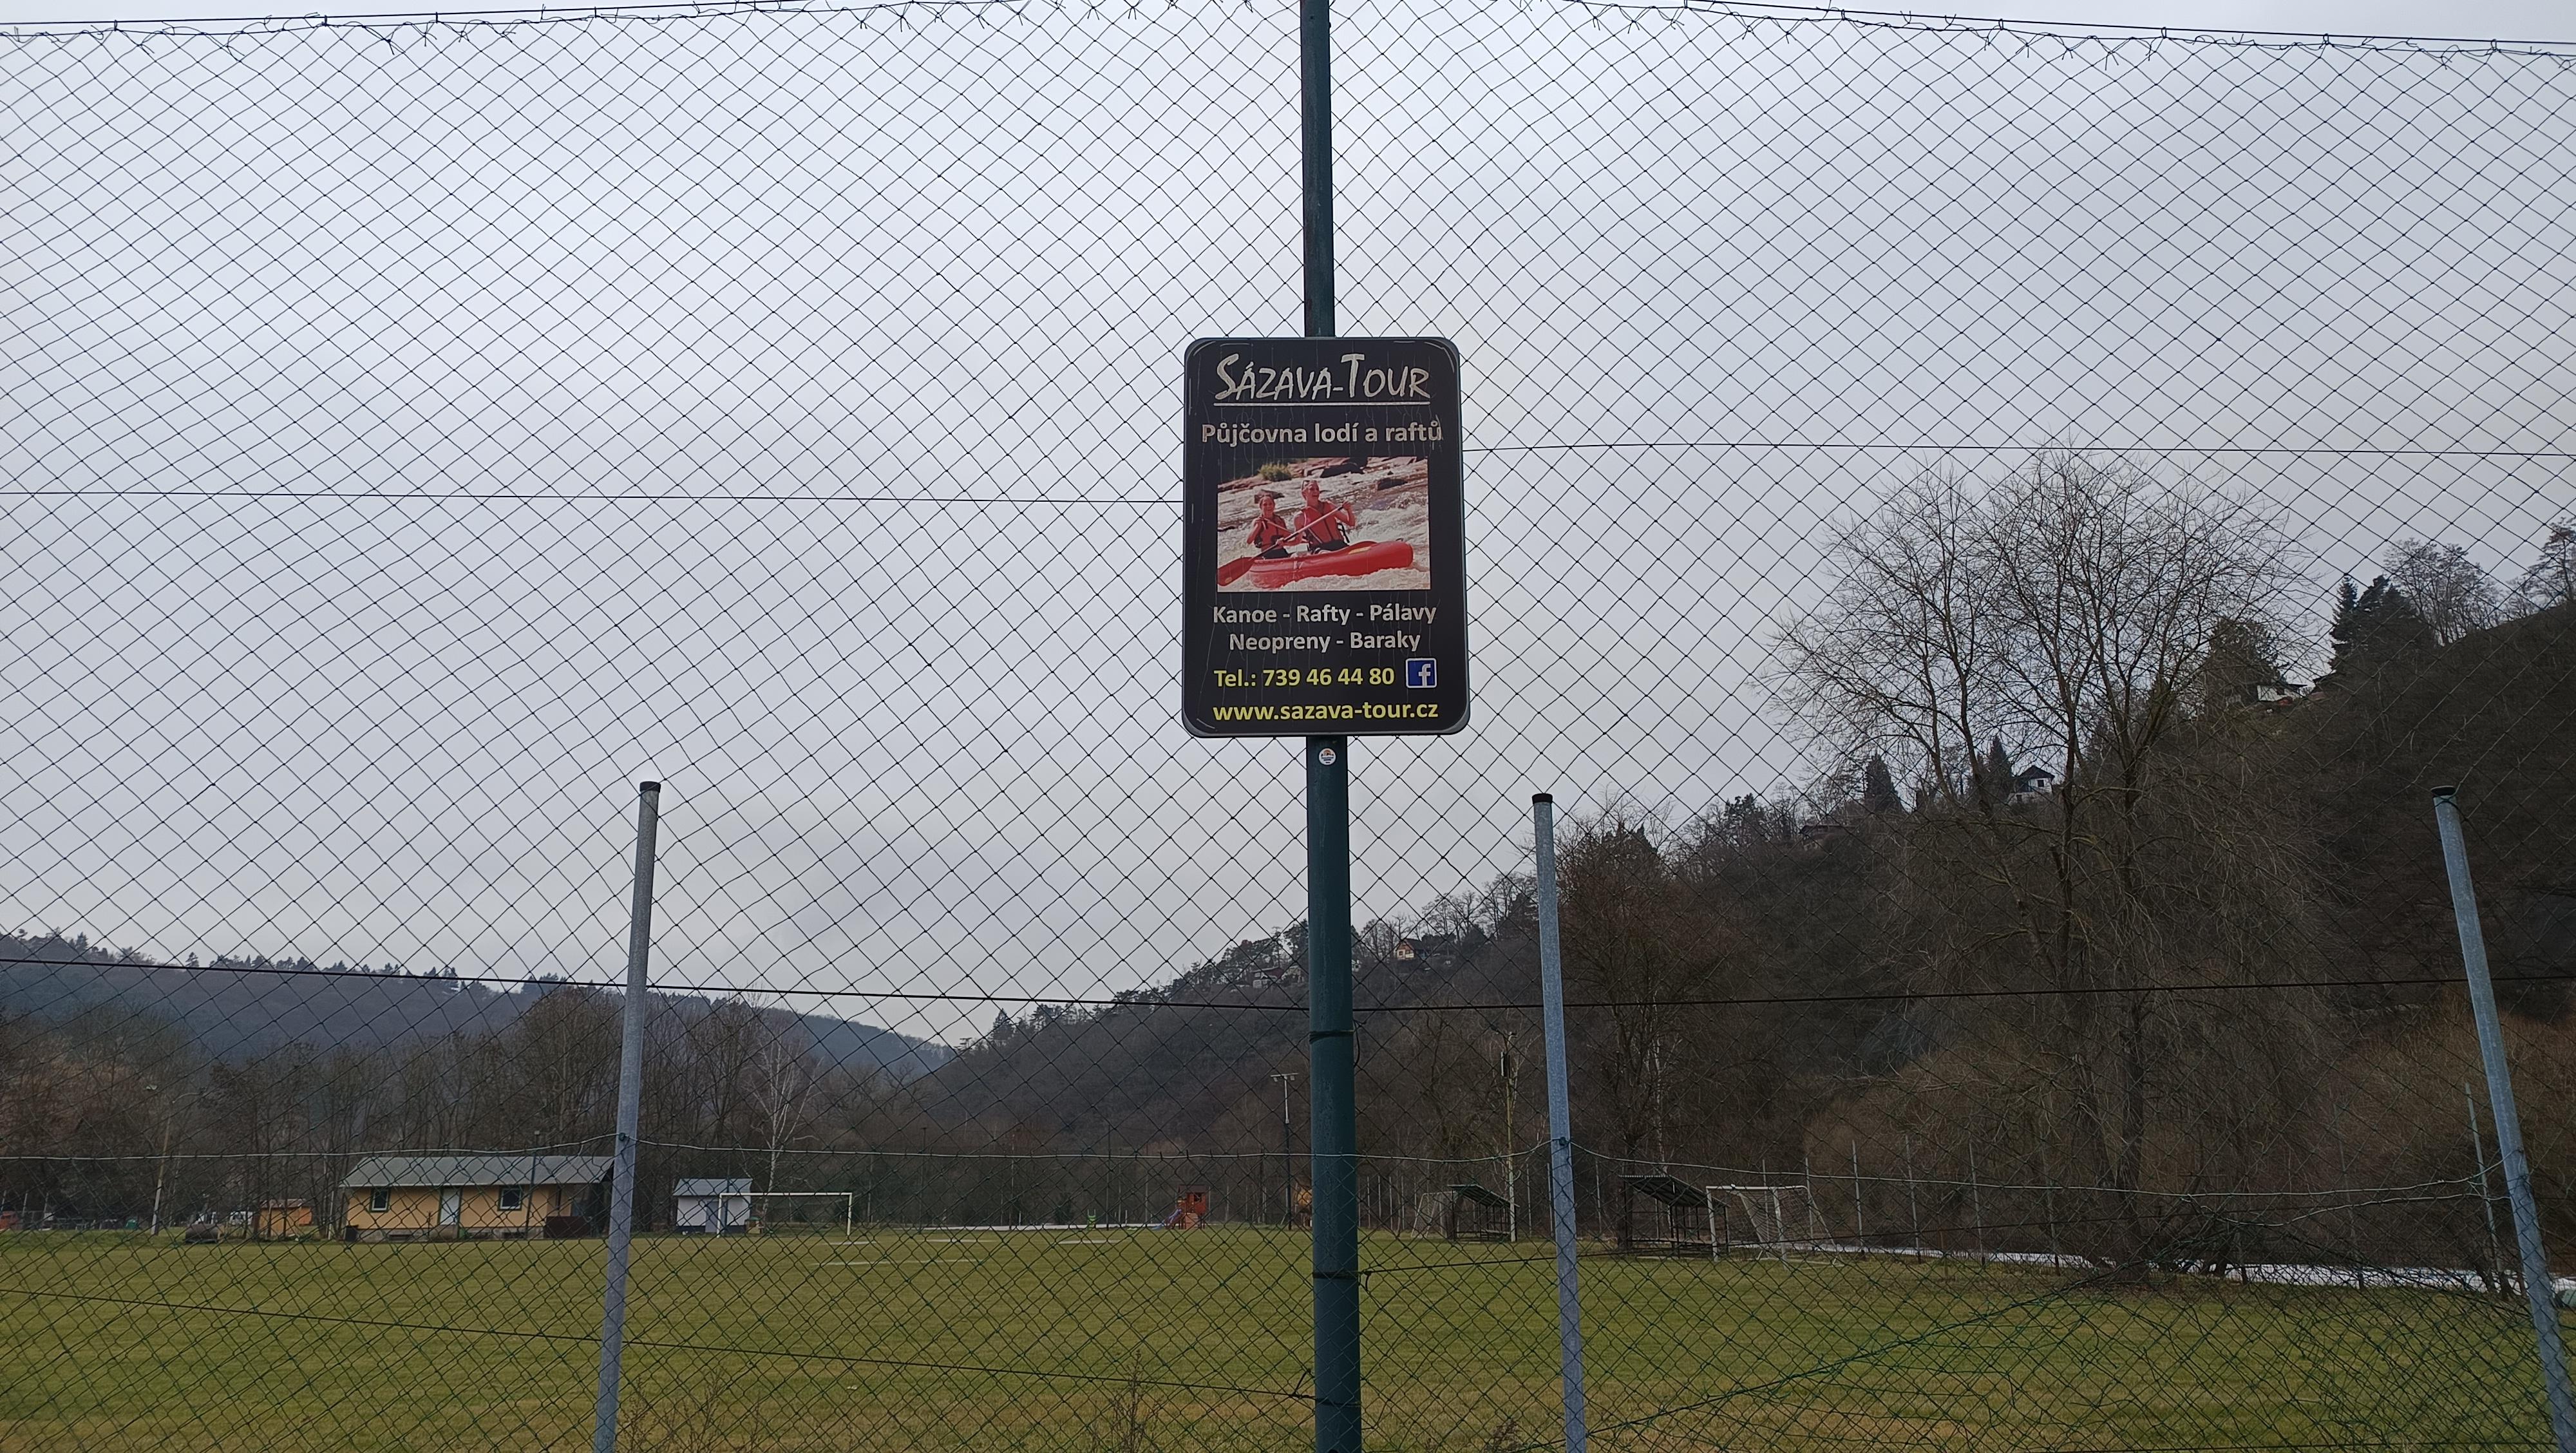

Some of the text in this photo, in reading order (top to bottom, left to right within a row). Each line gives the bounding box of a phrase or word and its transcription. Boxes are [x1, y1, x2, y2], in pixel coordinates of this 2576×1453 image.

[1215, 354, 1430, 401] SÁZAVA-TOUR
[1202, 420, 1441, 447] Půjčovna lodí a raftů
[1213, 605, 1277, 623] Kanoe
[1296, 604, 1351, 625] Rafty
[1370, 603, 1437, 624] Pálavy
[1229, 634, 1331, 654] Neopreny
[1350, 631, 1421, 651] Baraky
[1214, 667, 1394, 687] Tel.: 739 46 44 80
[1418, 663, 1431, 687] f
[1213, 701, 1439, 720] www.sazava-tour.cz
